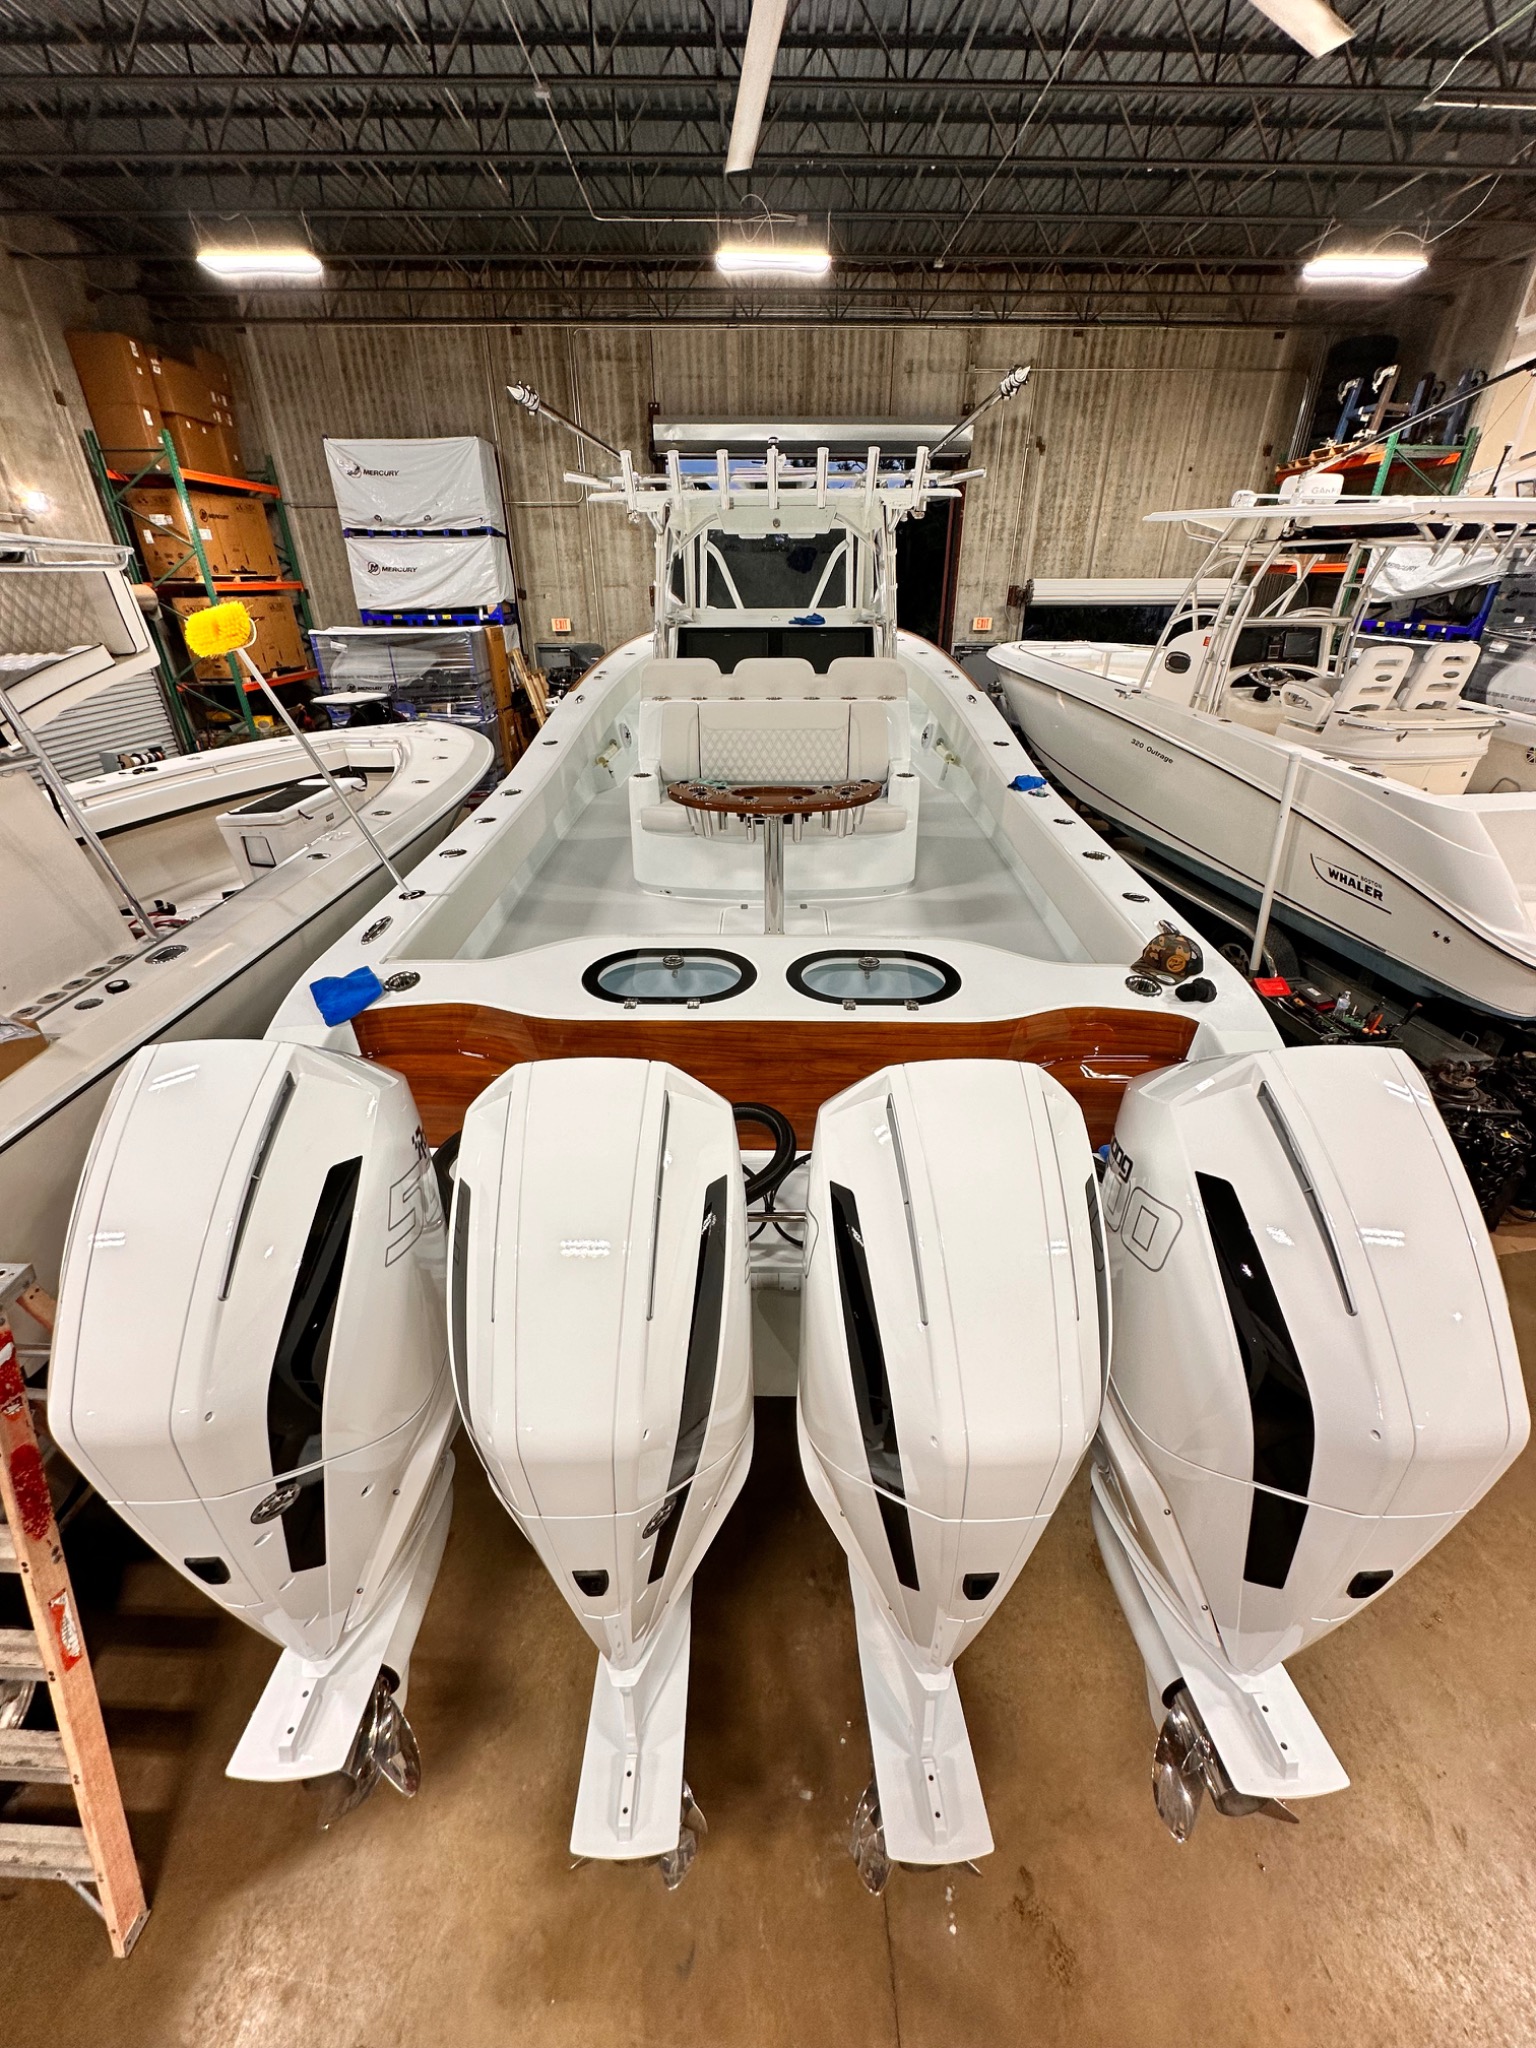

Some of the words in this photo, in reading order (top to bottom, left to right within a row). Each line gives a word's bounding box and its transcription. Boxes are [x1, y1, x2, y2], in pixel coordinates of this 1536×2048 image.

[363, 468, 399, 477] MERCURY
[555, 619, 568, 630] EXIT
[976, 618, 990, 629] EXIT
[1131, 738, 1145, 749] 320
[1146, 746, 1174, 764] Outrage
[1328, 866, 1383, 901] WHALER
[1360, 875, 1383, 889] BOSTON
